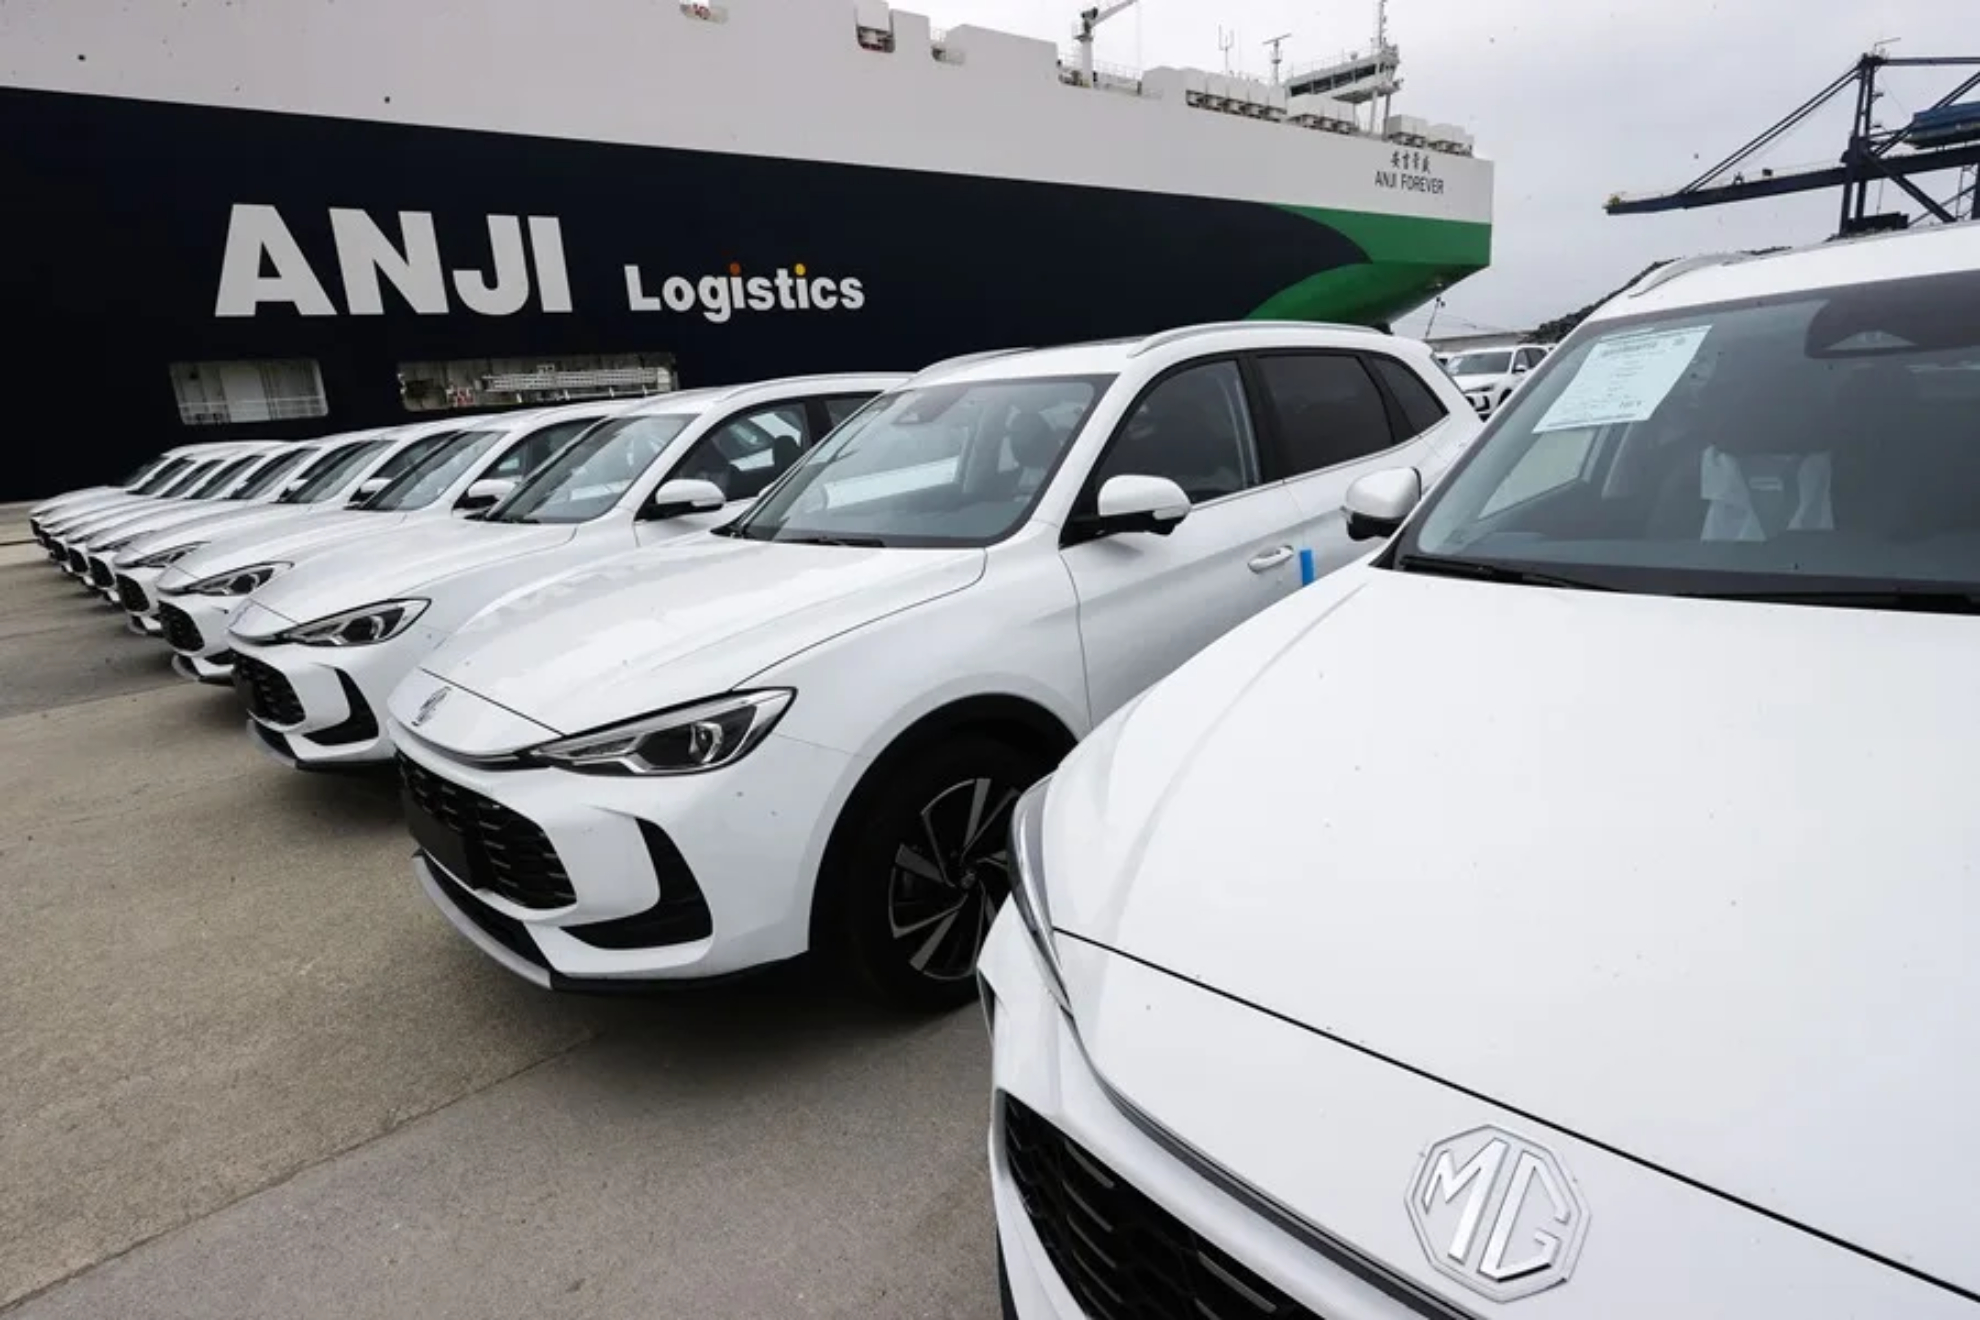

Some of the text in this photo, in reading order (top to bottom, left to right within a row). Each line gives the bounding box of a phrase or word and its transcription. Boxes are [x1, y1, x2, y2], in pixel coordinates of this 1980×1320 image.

[1374, 171, 1444, 195] ANJI FOREVER
[214, 203, 865, 323] ANJI Logistics
[1421, 1137, 1571, 1283] MG
